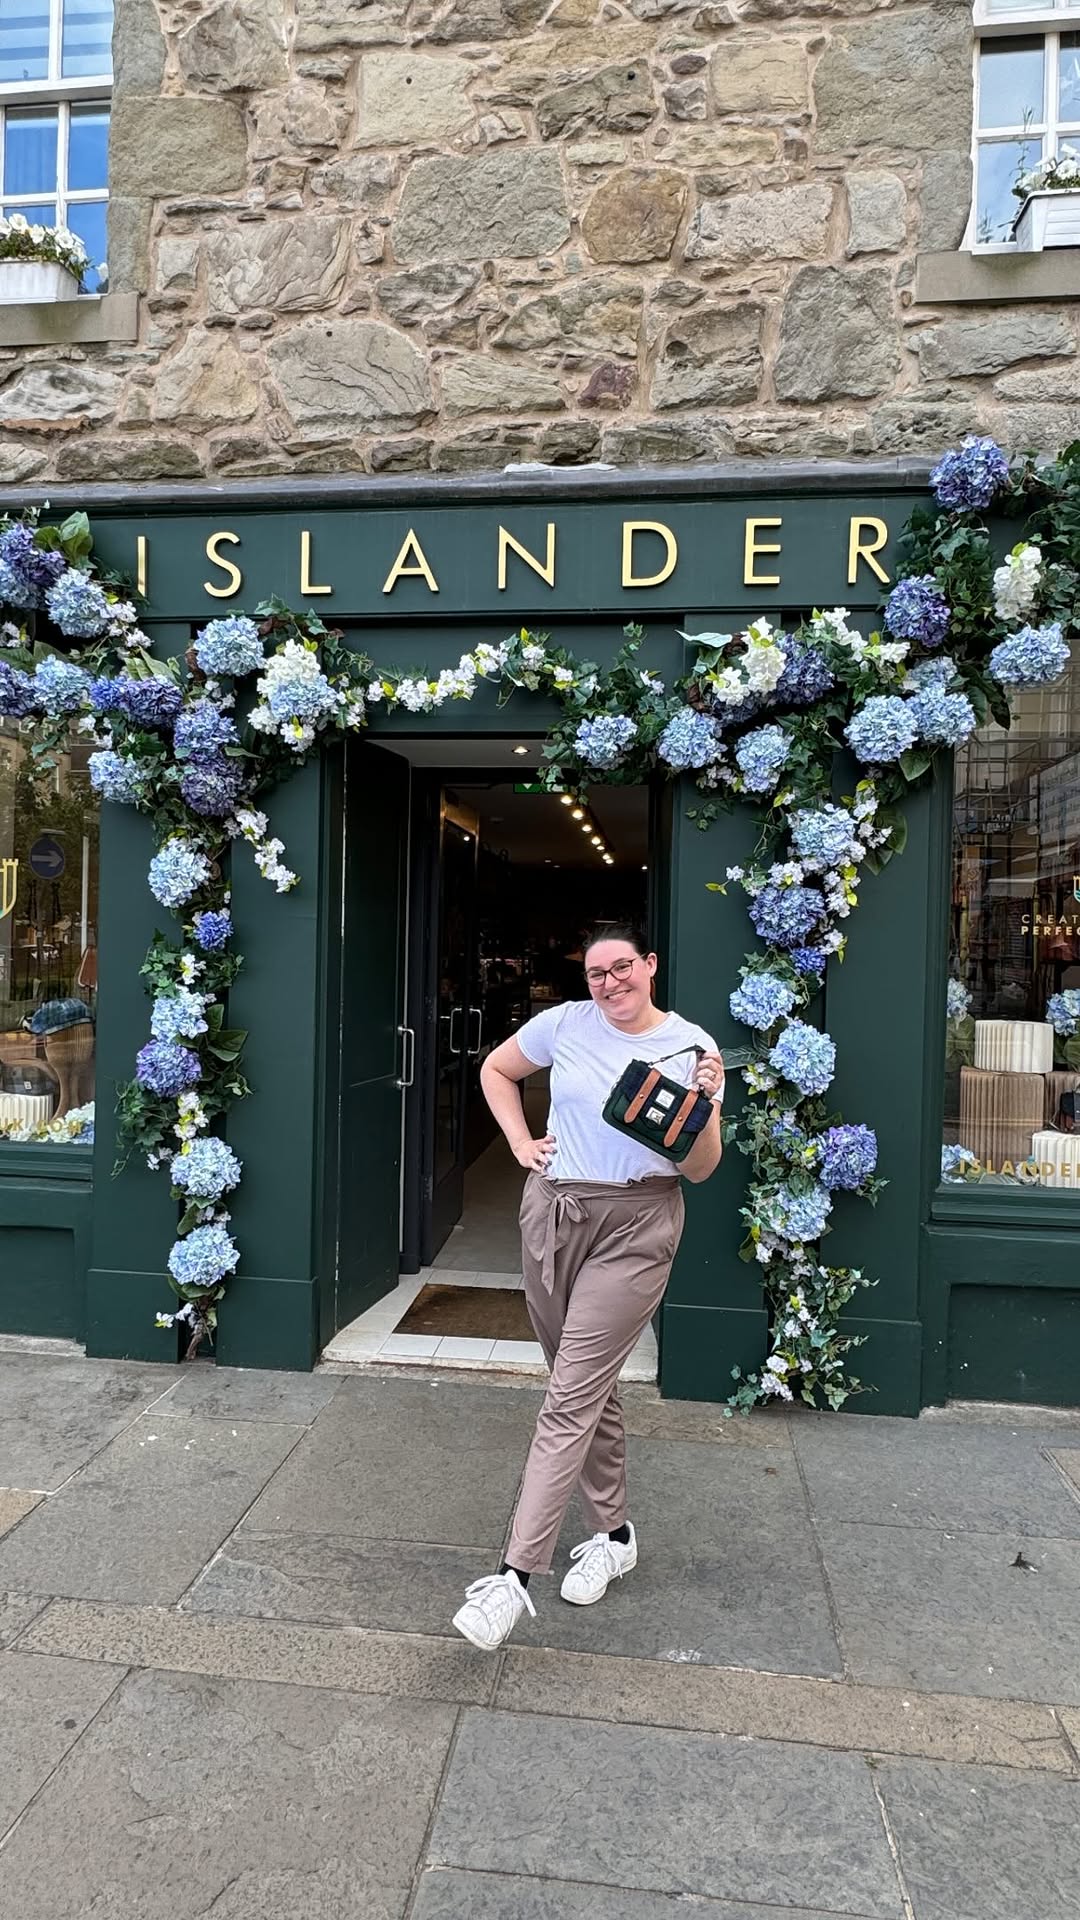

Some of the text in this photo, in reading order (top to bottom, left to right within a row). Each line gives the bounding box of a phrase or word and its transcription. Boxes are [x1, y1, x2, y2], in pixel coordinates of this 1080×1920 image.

[137, 516, 891, 599] ISLANDER
[1021, 914, 1079, 924] CREAT
[957, 1159, 1080, 1178] ISLANDE
